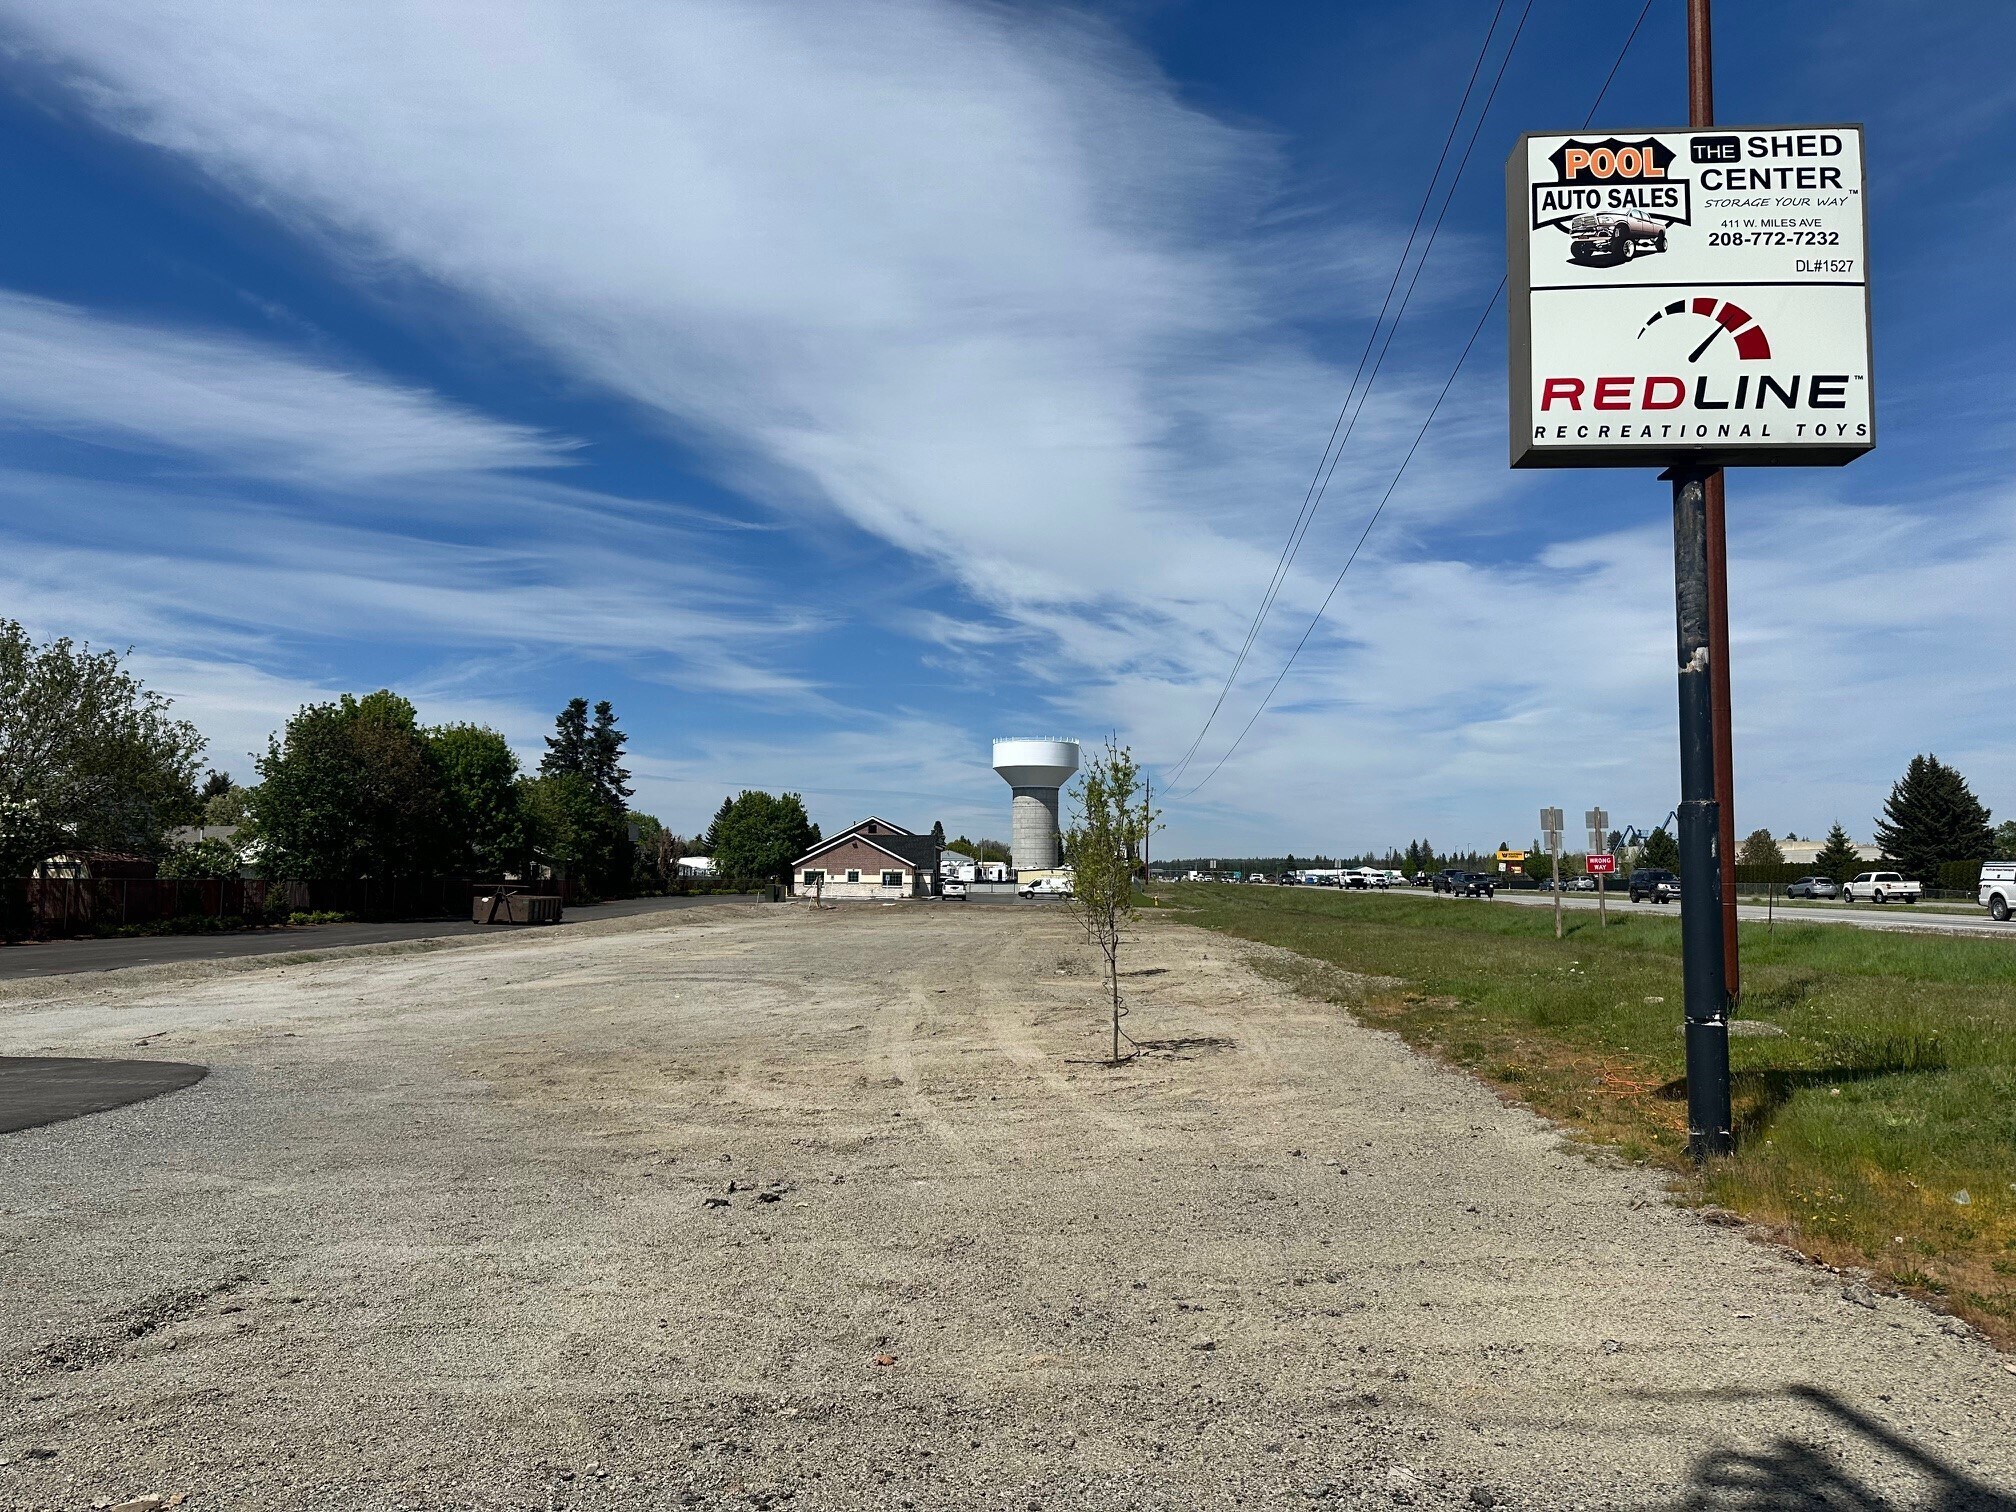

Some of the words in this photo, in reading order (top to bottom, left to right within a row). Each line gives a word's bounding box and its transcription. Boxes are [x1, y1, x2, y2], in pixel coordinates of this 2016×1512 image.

[1693, 145, 1736, 159] THE
[1747, 135, 1843, 158] SHED
[1564, 147, 1665, 179] POOL
[1700, 166, 1843, 191] CENTER
[1542, 189, 1601, 211] AUTO
[1608, 188, 1678, 209] SALES
[1704, 198, 1771, 208] STORAGE
[1775, 197, 1813, 207] YOUR
[1817, 196, 1849, 207] WAY
[1721, 219, 1741, 228] 411
[1743, 219, 1757, 227] W.
[1760, 219, 1796, 228] MILES
[1799, 218, 1822, 227] AVE
[1708, 232, 1839, 247] 208-772-7232
[1796, 259, 1854, 273] DL#1527
[1540, 375, 1850, 412] REDLINE
[1534, 424, 1771, 439] RECREATIONAL
[1797, 423, 1867, 438] TOYS
